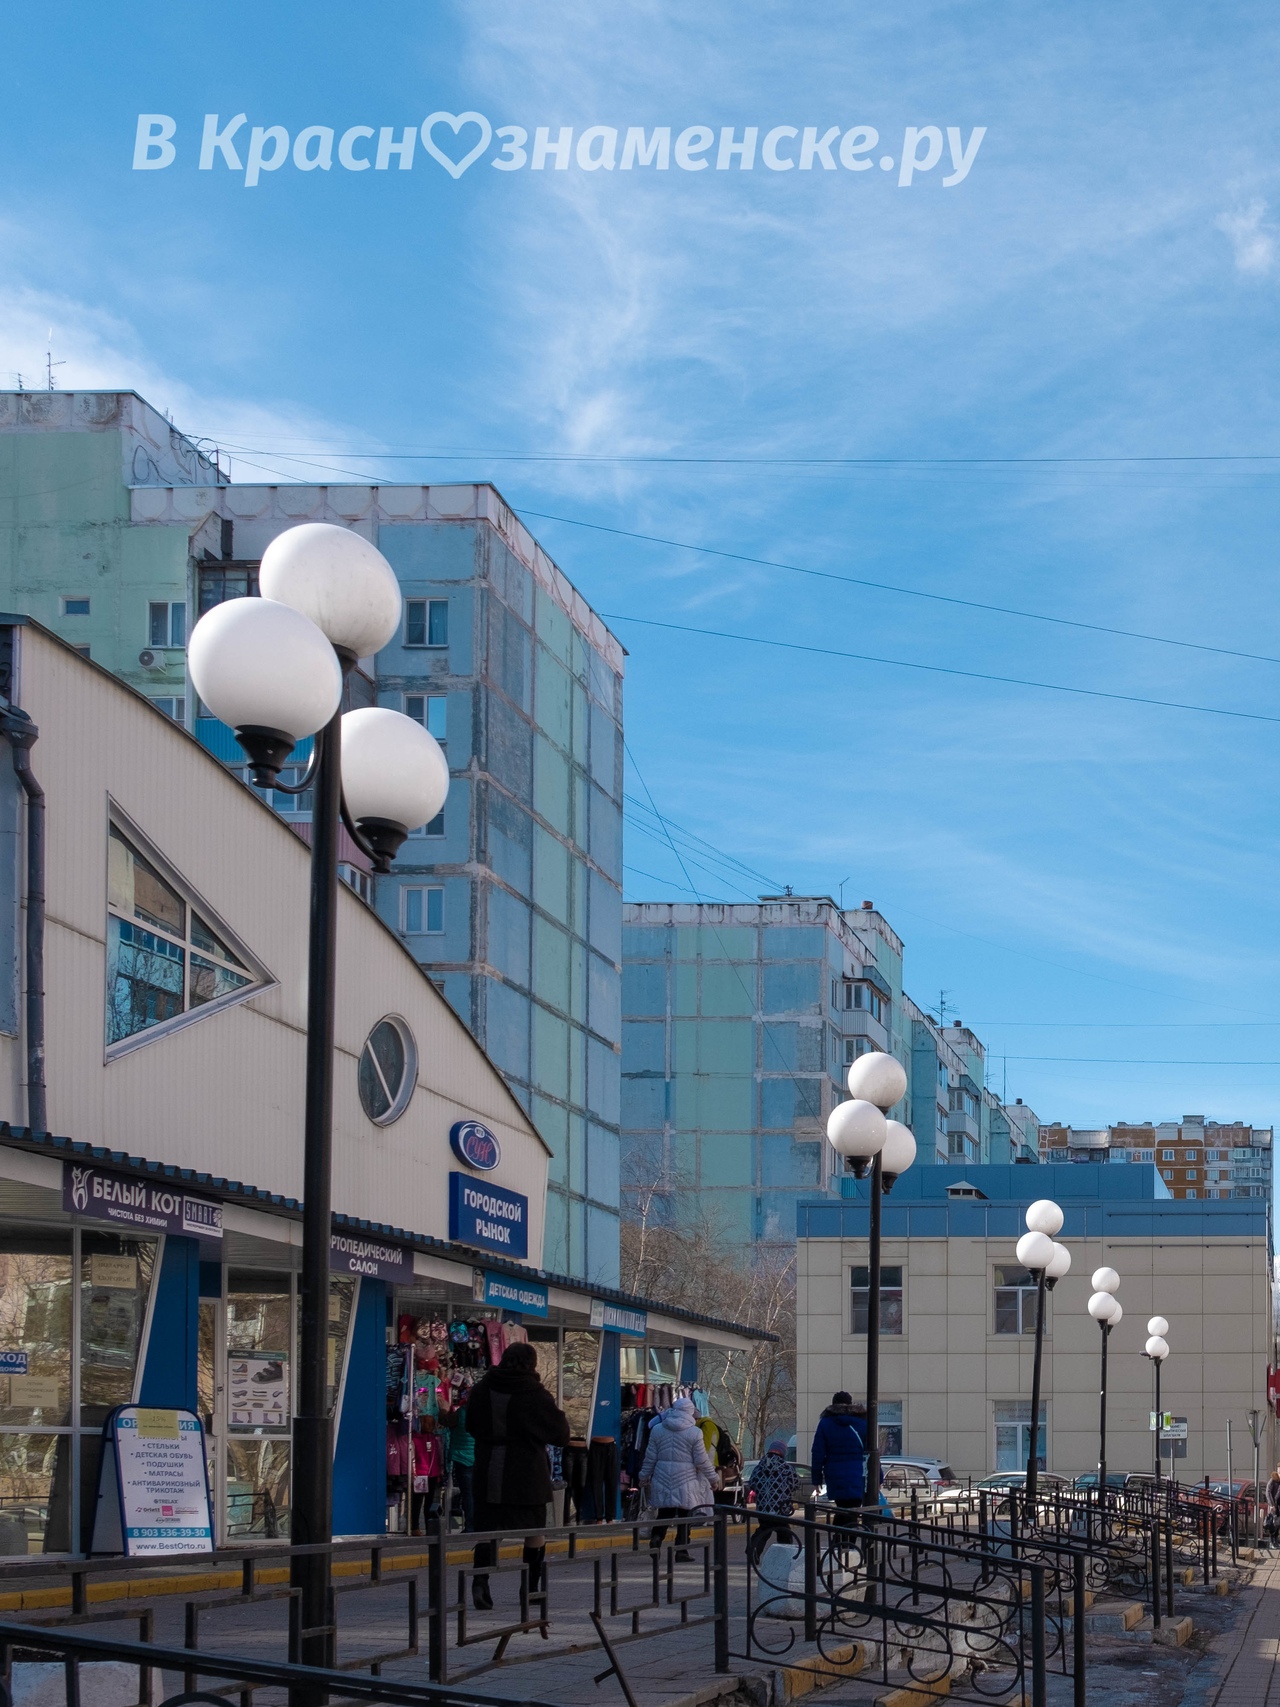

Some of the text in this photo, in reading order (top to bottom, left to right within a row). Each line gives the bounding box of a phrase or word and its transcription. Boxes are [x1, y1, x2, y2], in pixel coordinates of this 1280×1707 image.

[93, 1176, 182, 1216] БЕЛЫЙ КОТ
[464, 1188, 522, 1223] ГОРОДСКОЙ
[107, 1207, 168, 1228] ЧИСТОТА БЕЗ ХИМИИ
[186, 1202, 212, 1224] SMART
[476, 1218, 511, 1244] РЫНОК
[329, 1234, 403, 1265] РТОПЕДИЧЕСКИЙ
[349, 1258, 378, 1275] САЛОН
[489, 1282, 546, 1308] ДЕТСКАЯ ОДЕЖДА
[135, 1451, 193, 1460] ДЕТСКАЯ ОБУВЬ
[147, 1442, 180, 1450] СТЕЛЬКИ
[132, 1480, 201, 1488] АНТИВАРИКОЗНЫЙ
[133, 1528, 206, 1537] 8 903 536-39-30
[136, 1542, 206, 1550] www.BestOrto.ru
